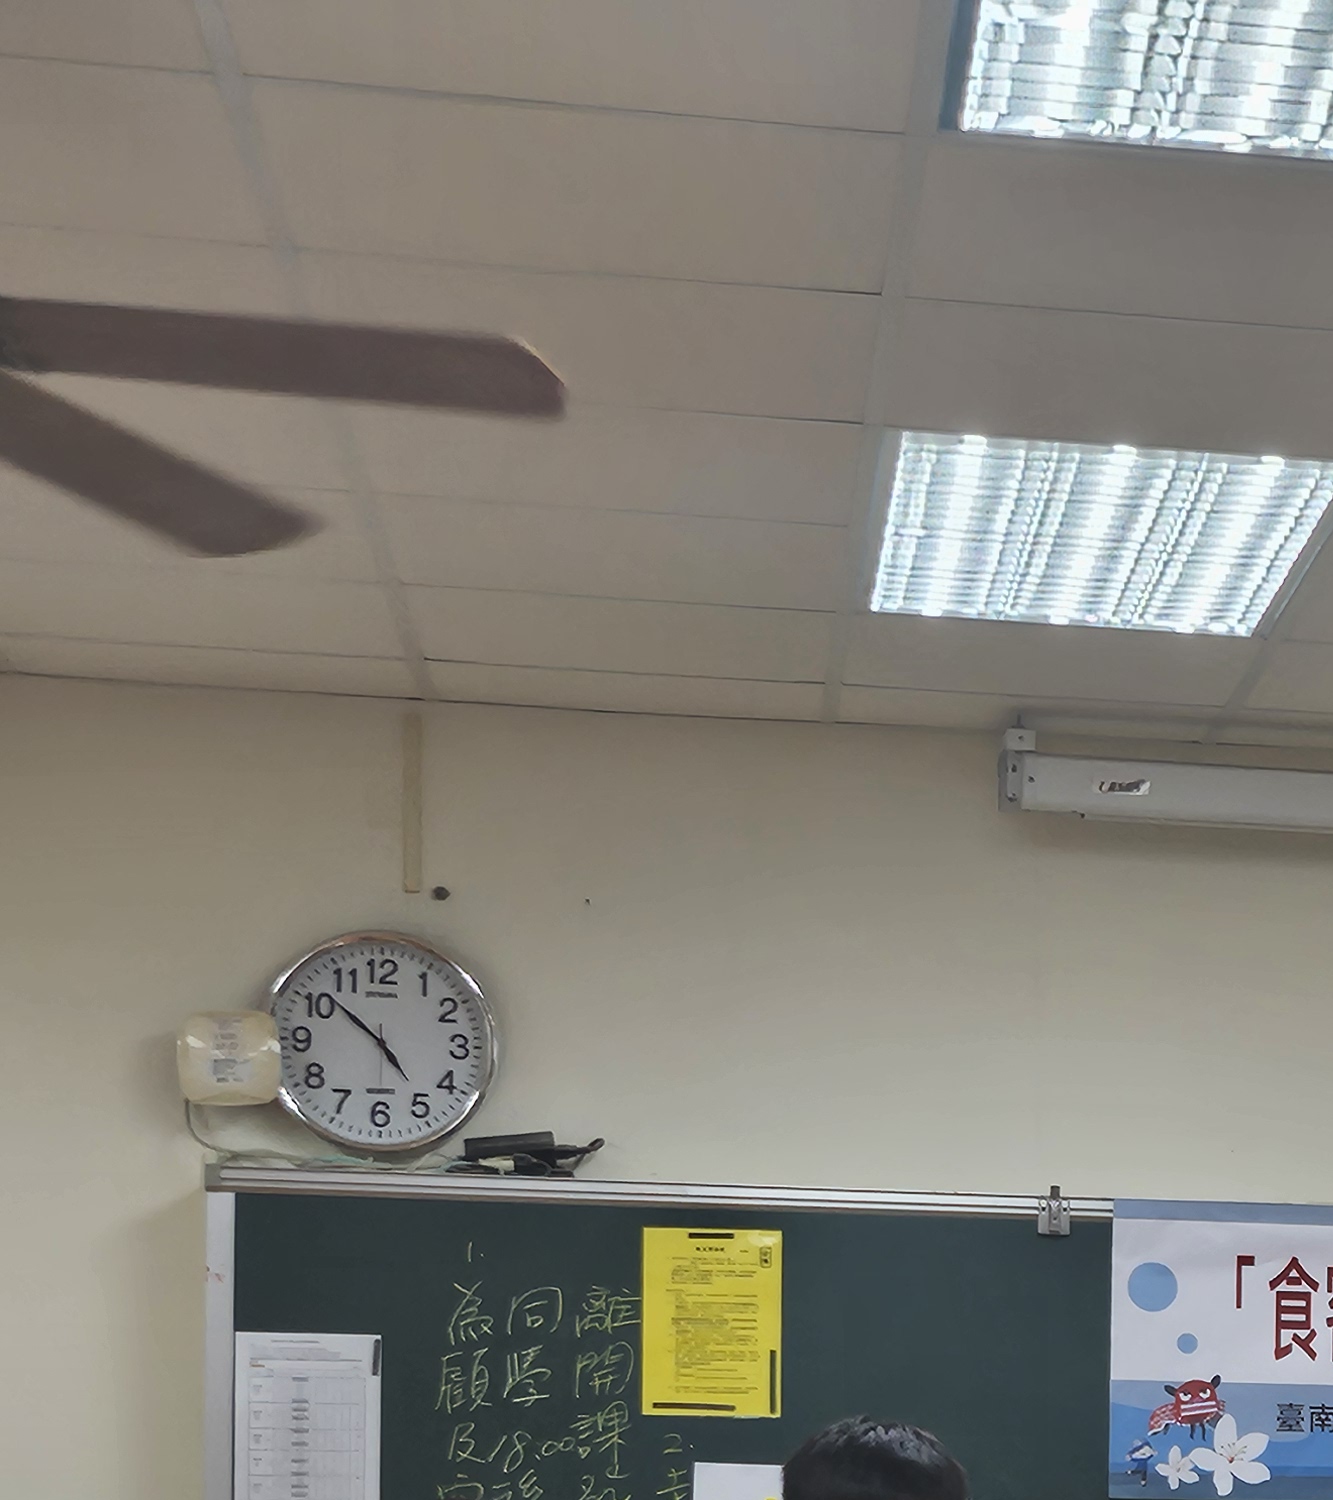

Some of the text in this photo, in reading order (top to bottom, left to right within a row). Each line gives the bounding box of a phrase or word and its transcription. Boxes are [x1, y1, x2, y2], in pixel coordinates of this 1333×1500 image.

[333, 968, 359, 993] 11
[366, 959, 398, 985] 12
[418, 972, 429, 997] 1
[305, 993, 335, 1019] 10
[439, 998, 459, 1023] 2
[291, 1026, 312, 1053] 9
[449, 1034, 470, 1060] 3
[305, 1063, 325, 1089] 8
[437, 1070, 457, 1095] 4
[332, 1089, 352, 1114] 7
[411, 1093, 430, 1118] 5
[371, 1101, 390, 1128] 6
